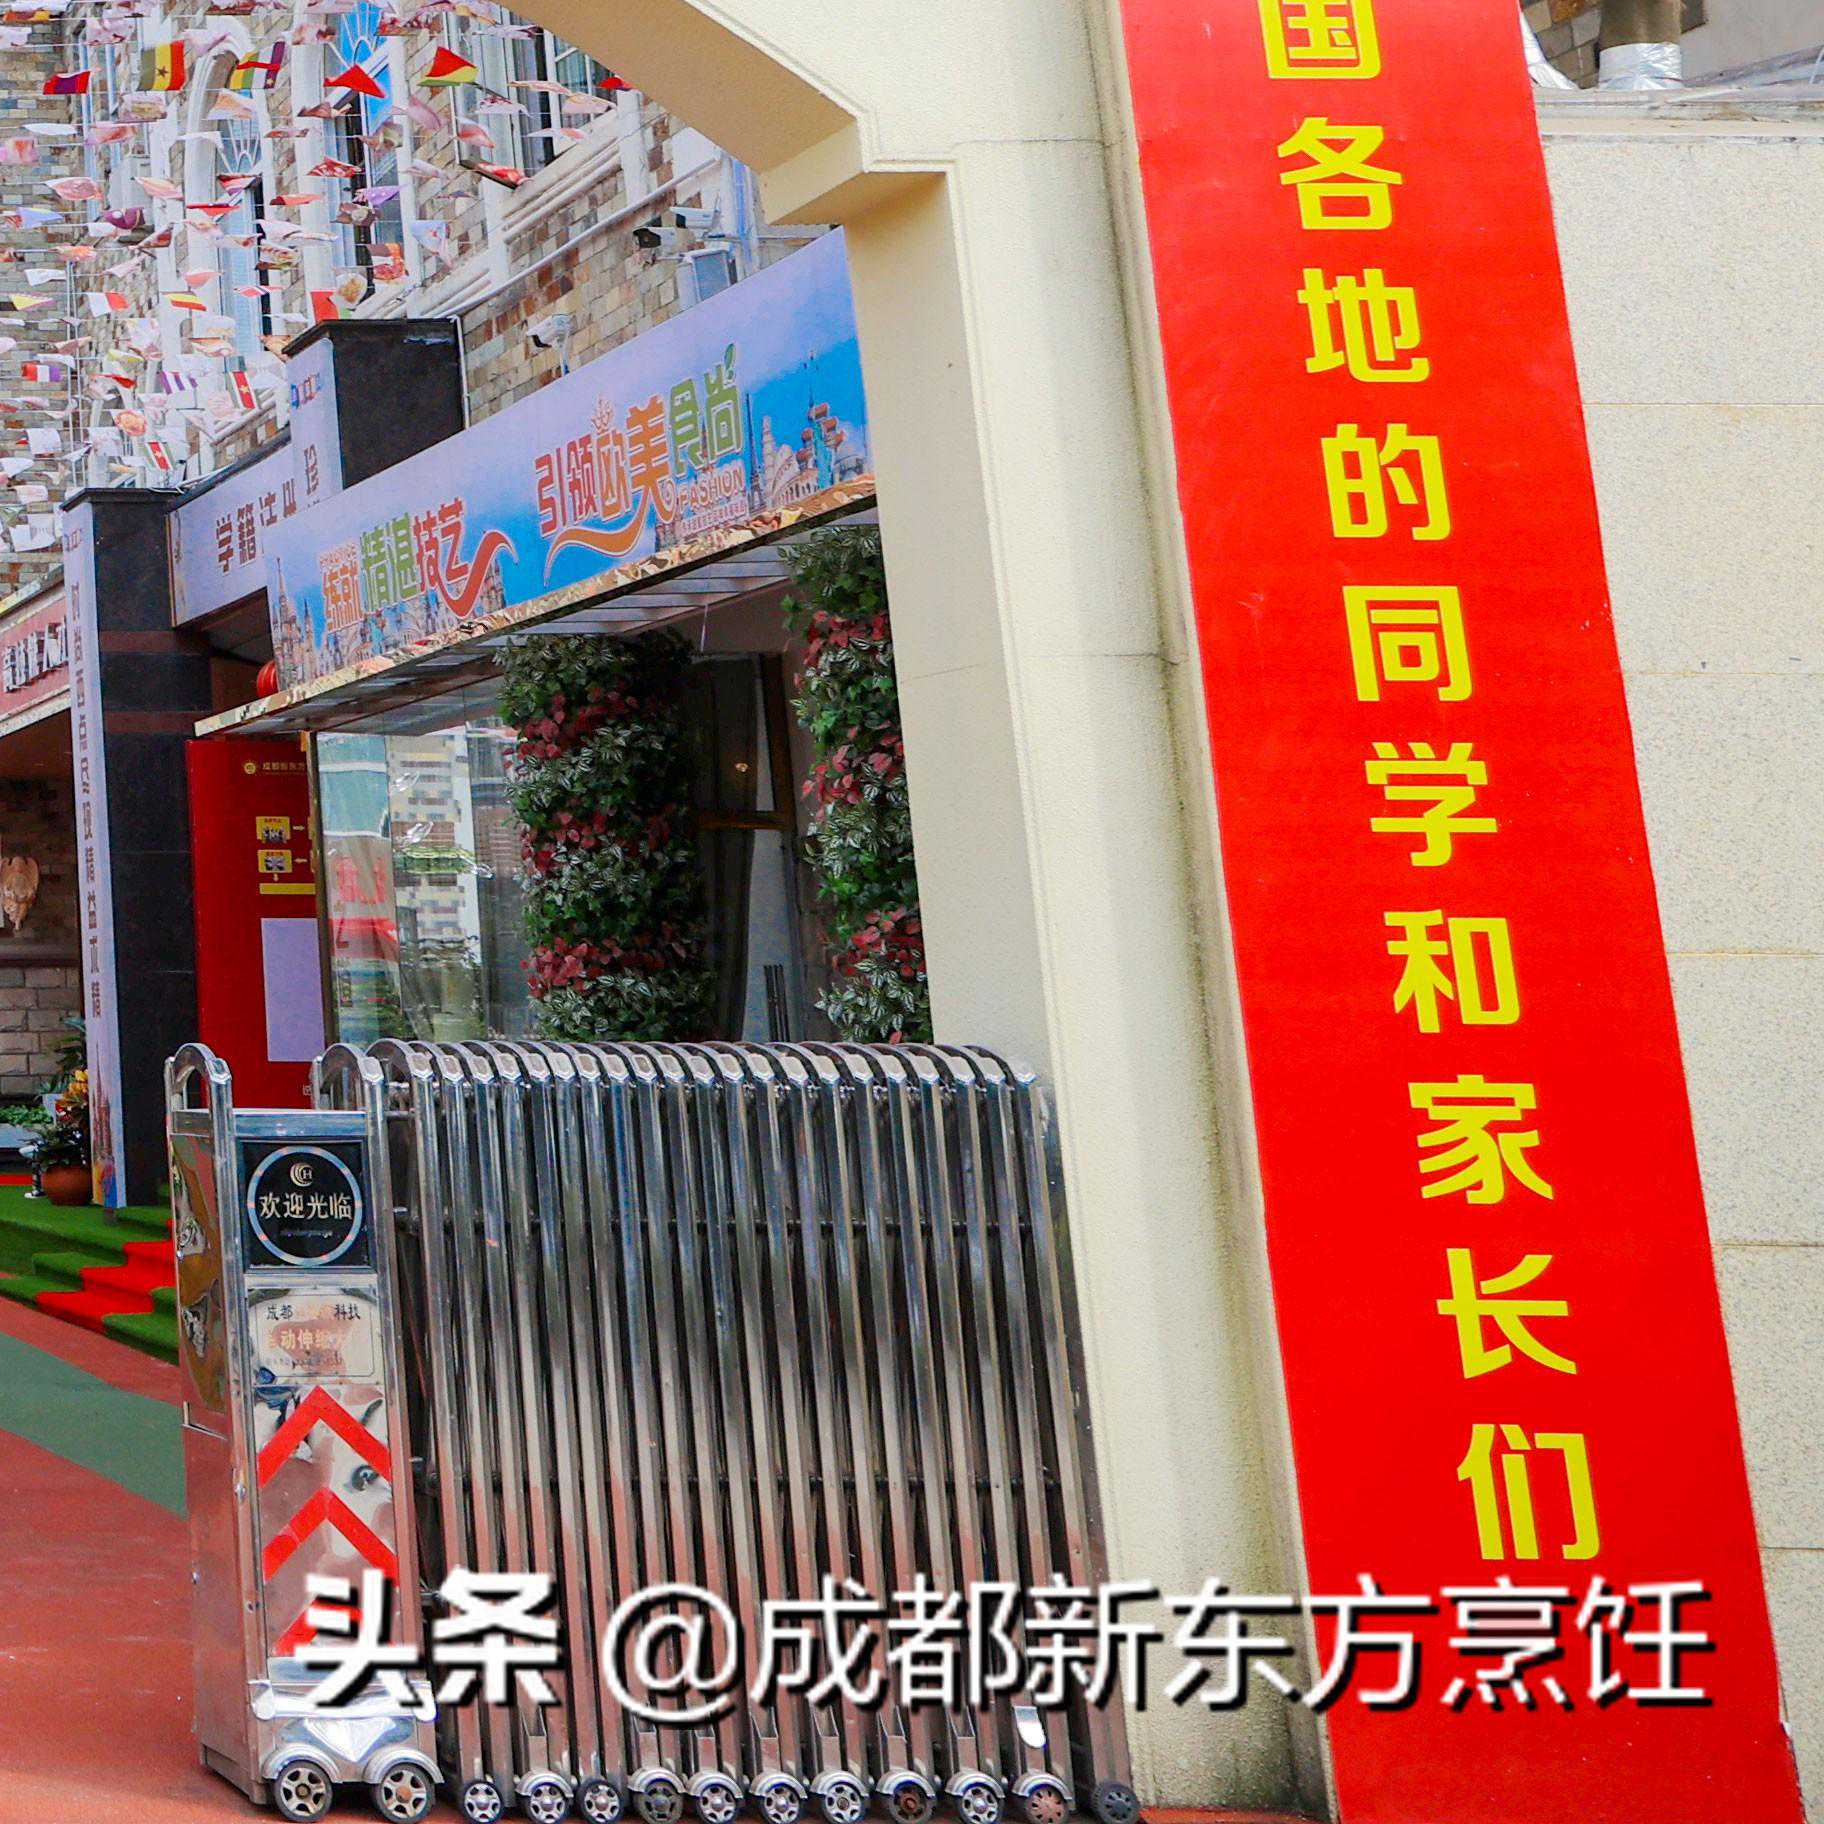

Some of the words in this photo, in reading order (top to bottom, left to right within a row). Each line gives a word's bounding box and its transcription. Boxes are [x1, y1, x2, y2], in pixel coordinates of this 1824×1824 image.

[535, 346, 743, 539] 引领欧美食尚
[677, 467, 746, 513] FASHION
[322, 497, 502, 633] 练就精湛技艺
[259, 1192, 353, 1220] 欢迎光临
